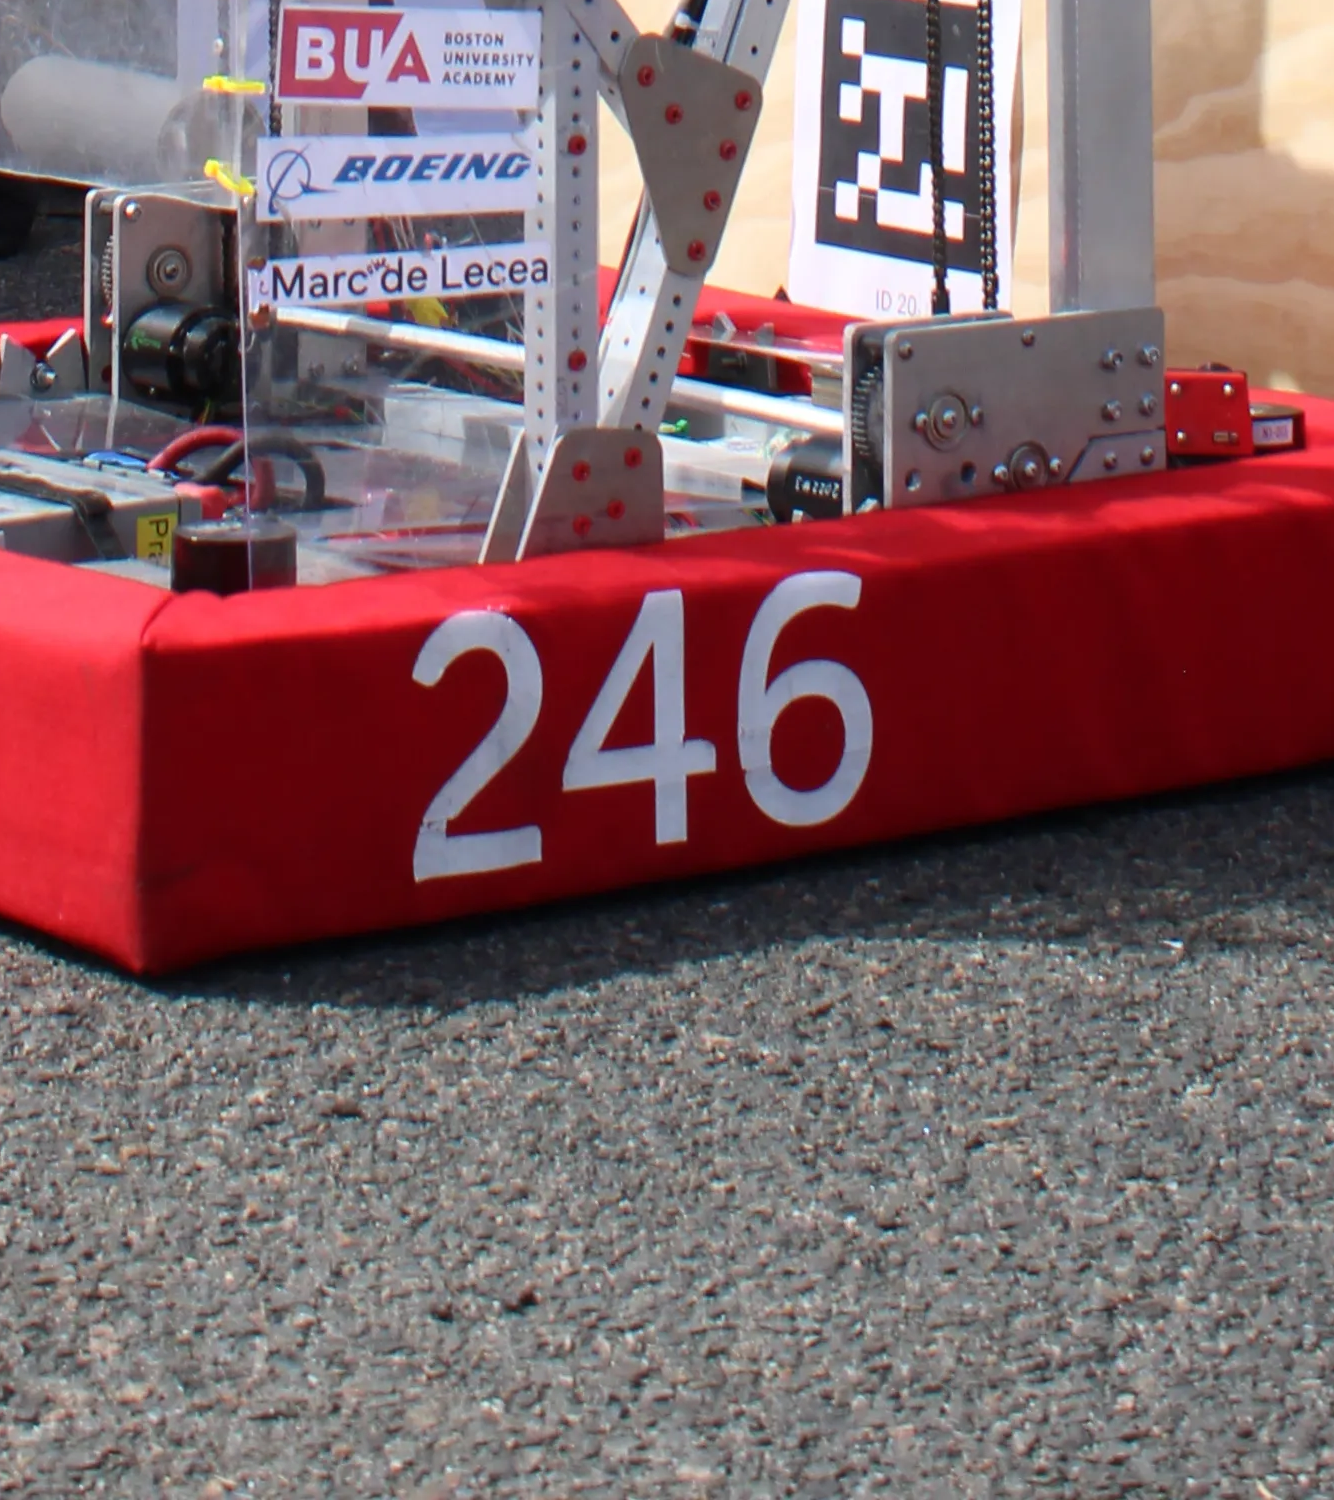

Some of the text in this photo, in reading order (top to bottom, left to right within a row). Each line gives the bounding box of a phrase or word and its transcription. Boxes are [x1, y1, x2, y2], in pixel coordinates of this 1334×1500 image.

[444, 32, 505, 47] BOSTON
[294, 26, 431, 83] BUA
[442, 52, 535, 68] UNIVERSITY
[441, 71, 516, 86] ACADEMY
[333, 153, 532, 183] BOEING
[271, 265, 368, 301] Marc
[380, 257, 428, 297] de
[441, 254, 549, 291] Lecea
[875, 288, 892, 312] ID
[410, 569, 873, 882] 246
